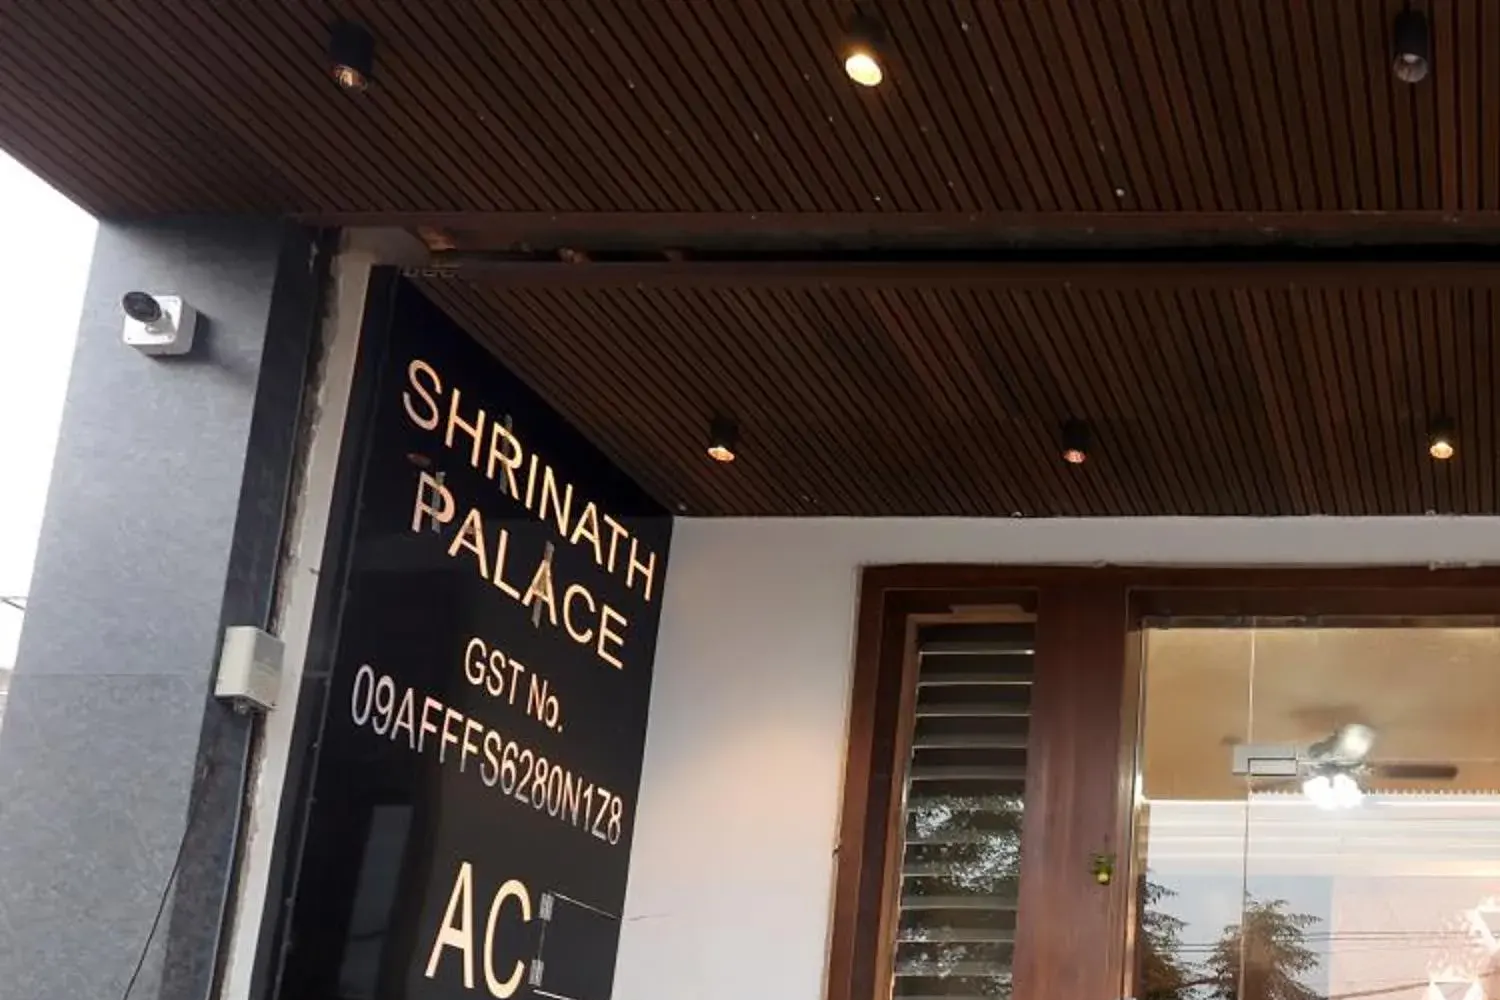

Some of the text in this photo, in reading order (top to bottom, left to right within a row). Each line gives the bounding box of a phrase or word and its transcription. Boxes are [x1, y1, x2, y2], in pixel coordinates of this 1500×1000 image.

[403, 359, 656, 601] SHRINATH
[411, 470, 631, 671] PALACE
[351, 664, 623, 845] 09AFFFS6280N1Z8
[465, 637, 563, 733] GST No.
[425, 861, 531, 999] AC
